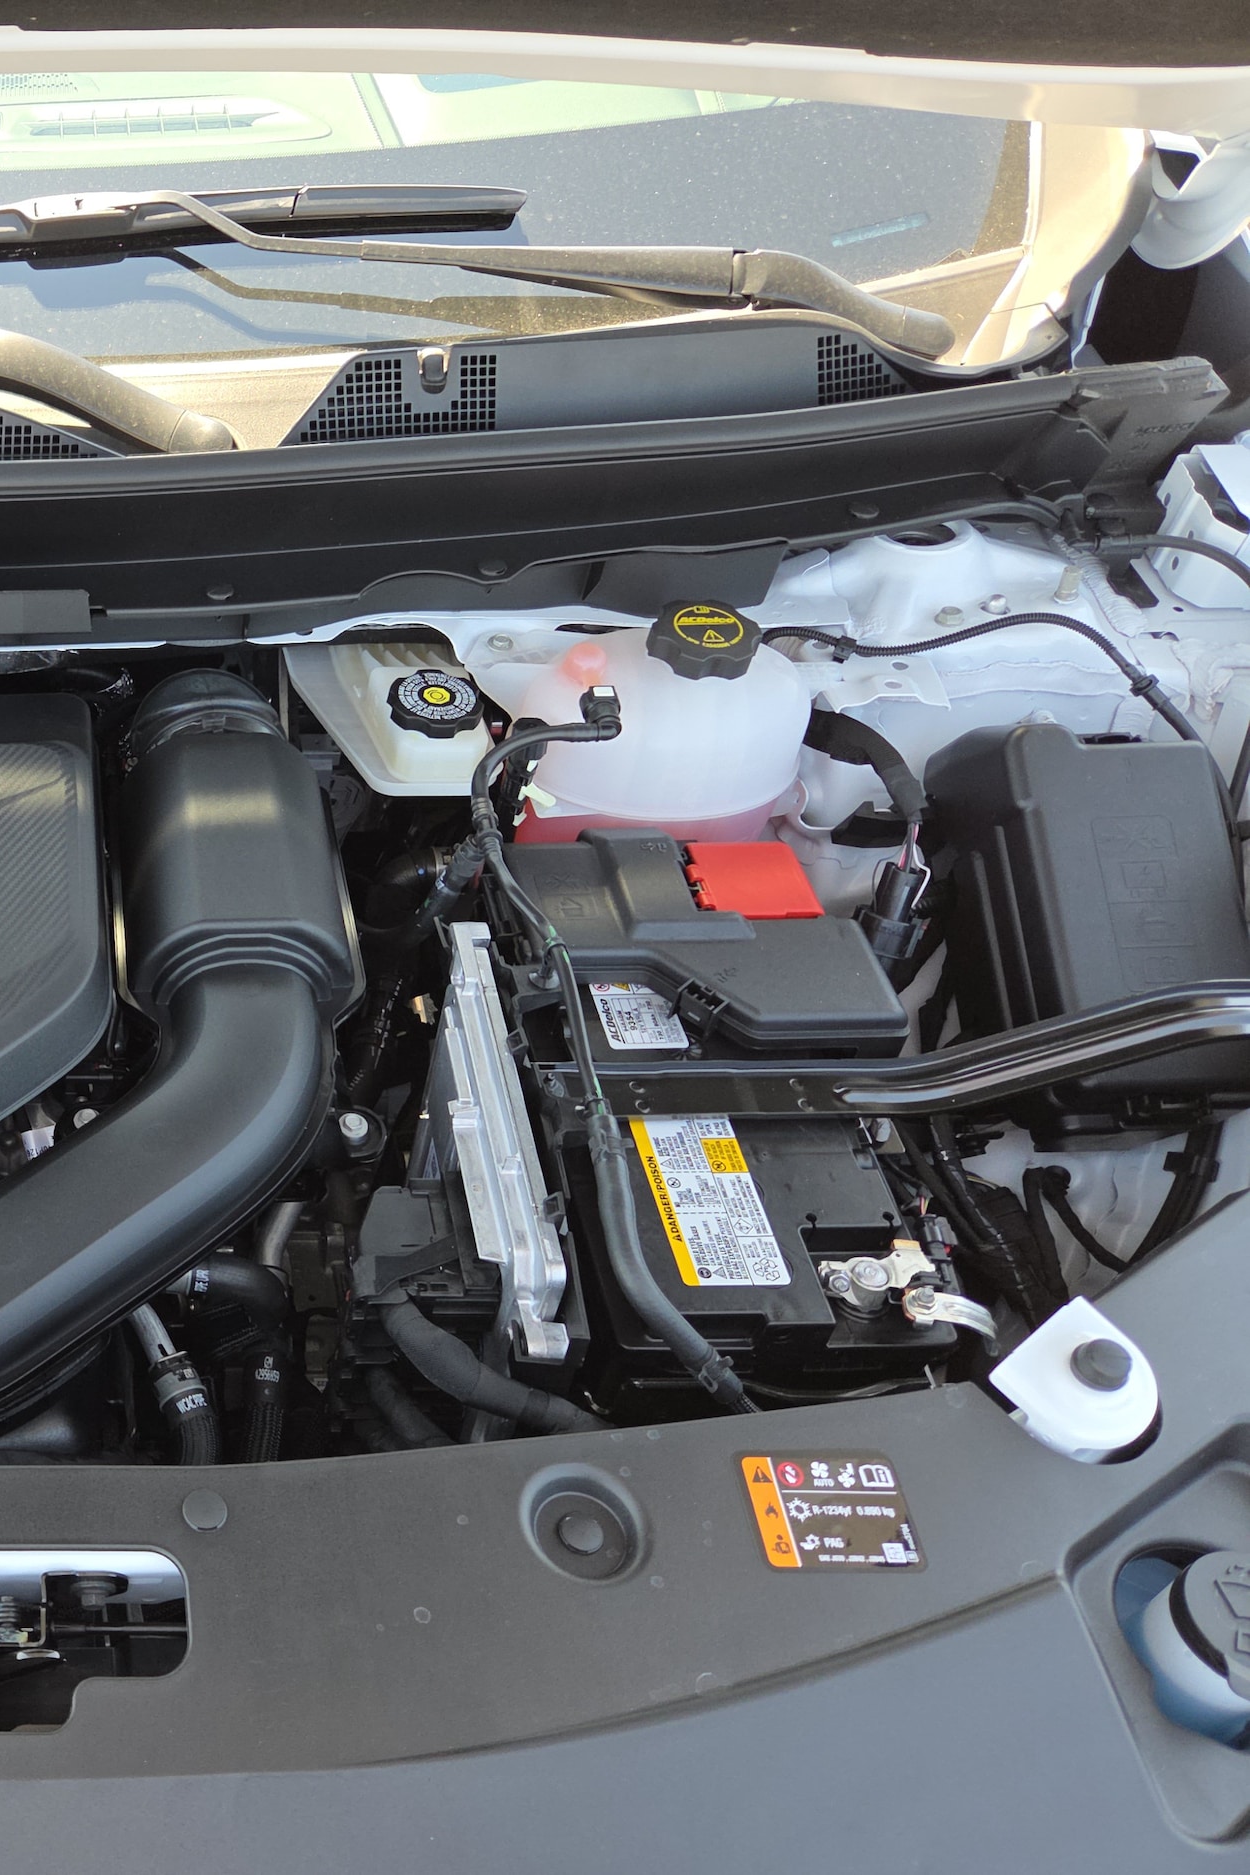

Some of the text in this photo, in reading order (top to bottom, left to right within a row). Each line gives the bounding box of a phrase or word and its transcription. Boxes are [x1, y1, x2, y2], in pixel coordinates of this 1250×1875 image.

[677, 616, 735, 625] ACDelco
[600, 998, 621, 1042] ACDelco
[646, 1156, 677, 1232] DANGER/POISON
[813, 1479, 835, 1487] AUTO
[823, 1537, 844, 1549] PAG
